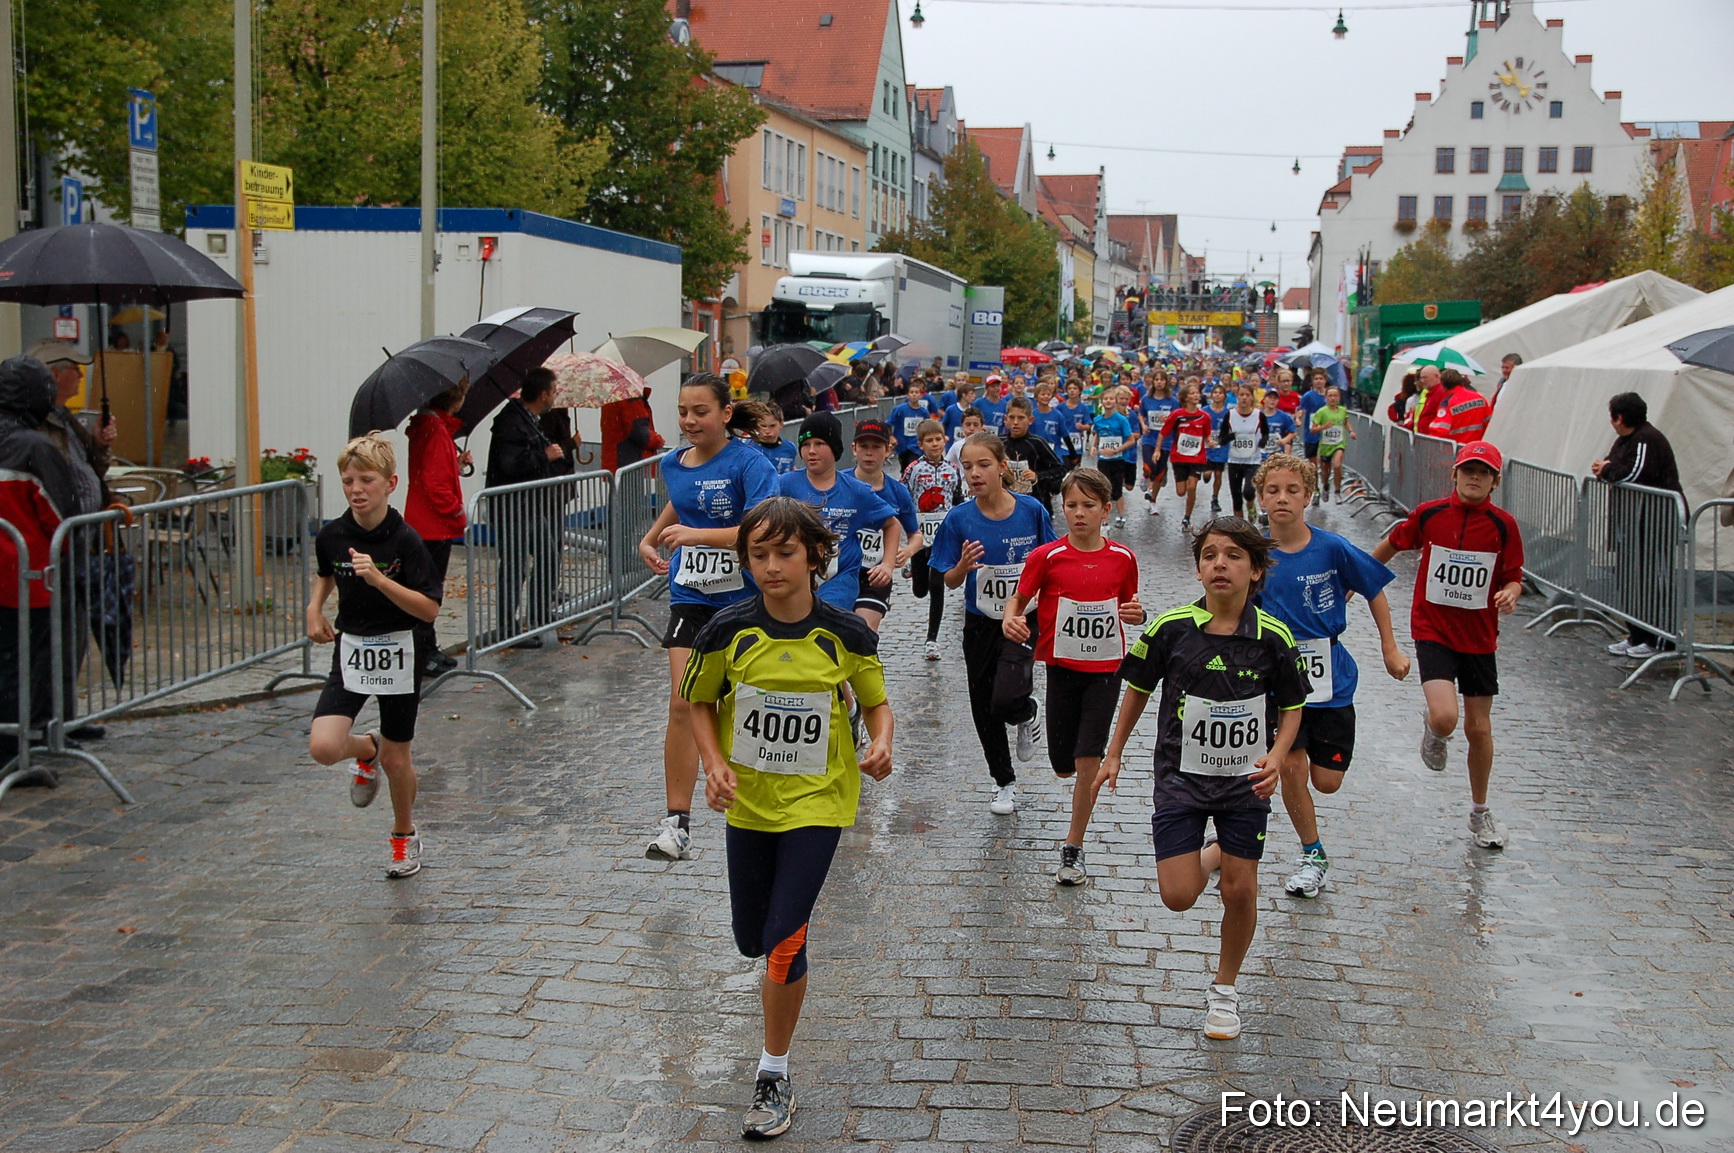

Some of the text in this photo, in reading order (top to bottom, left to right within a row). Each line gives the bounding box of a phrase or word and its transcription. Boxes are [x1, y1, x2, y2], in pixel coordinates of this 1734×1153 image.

[251, 166, 278, 180] Kinder-
[245, 179, 284, 199] betreuung
[66, 187, 78, 215] P
[799, 285, 849, 298] BOCK
[1178, 314, 1210, 323] START
[1233, 440, 1254, 449] 4089
[685, 551, 733, 574] 4075
[1434, 562, 1488, 588] 4000
[982, 579, 1019, 600] 407
[1444, 588, 1473, 601] Tobias
[1062, 615, 1116, 639] 4062
[1080, 643, 1098, 653] Leo
[347, 648, 404, 671] 4081
[1205, 664, 1227, 672] adidas
[360, 675, 394, 686] Florian
[764, 695, 805, 707] BOCK
[1210, 704, 1246, 714] BOCK
[743, 709, 822, 744] 4009
[1190, 717, 1259, 749] 4068
[758, 746, 798, 763] Daniel
[1200, 752, 1249, 768] Dogukan
